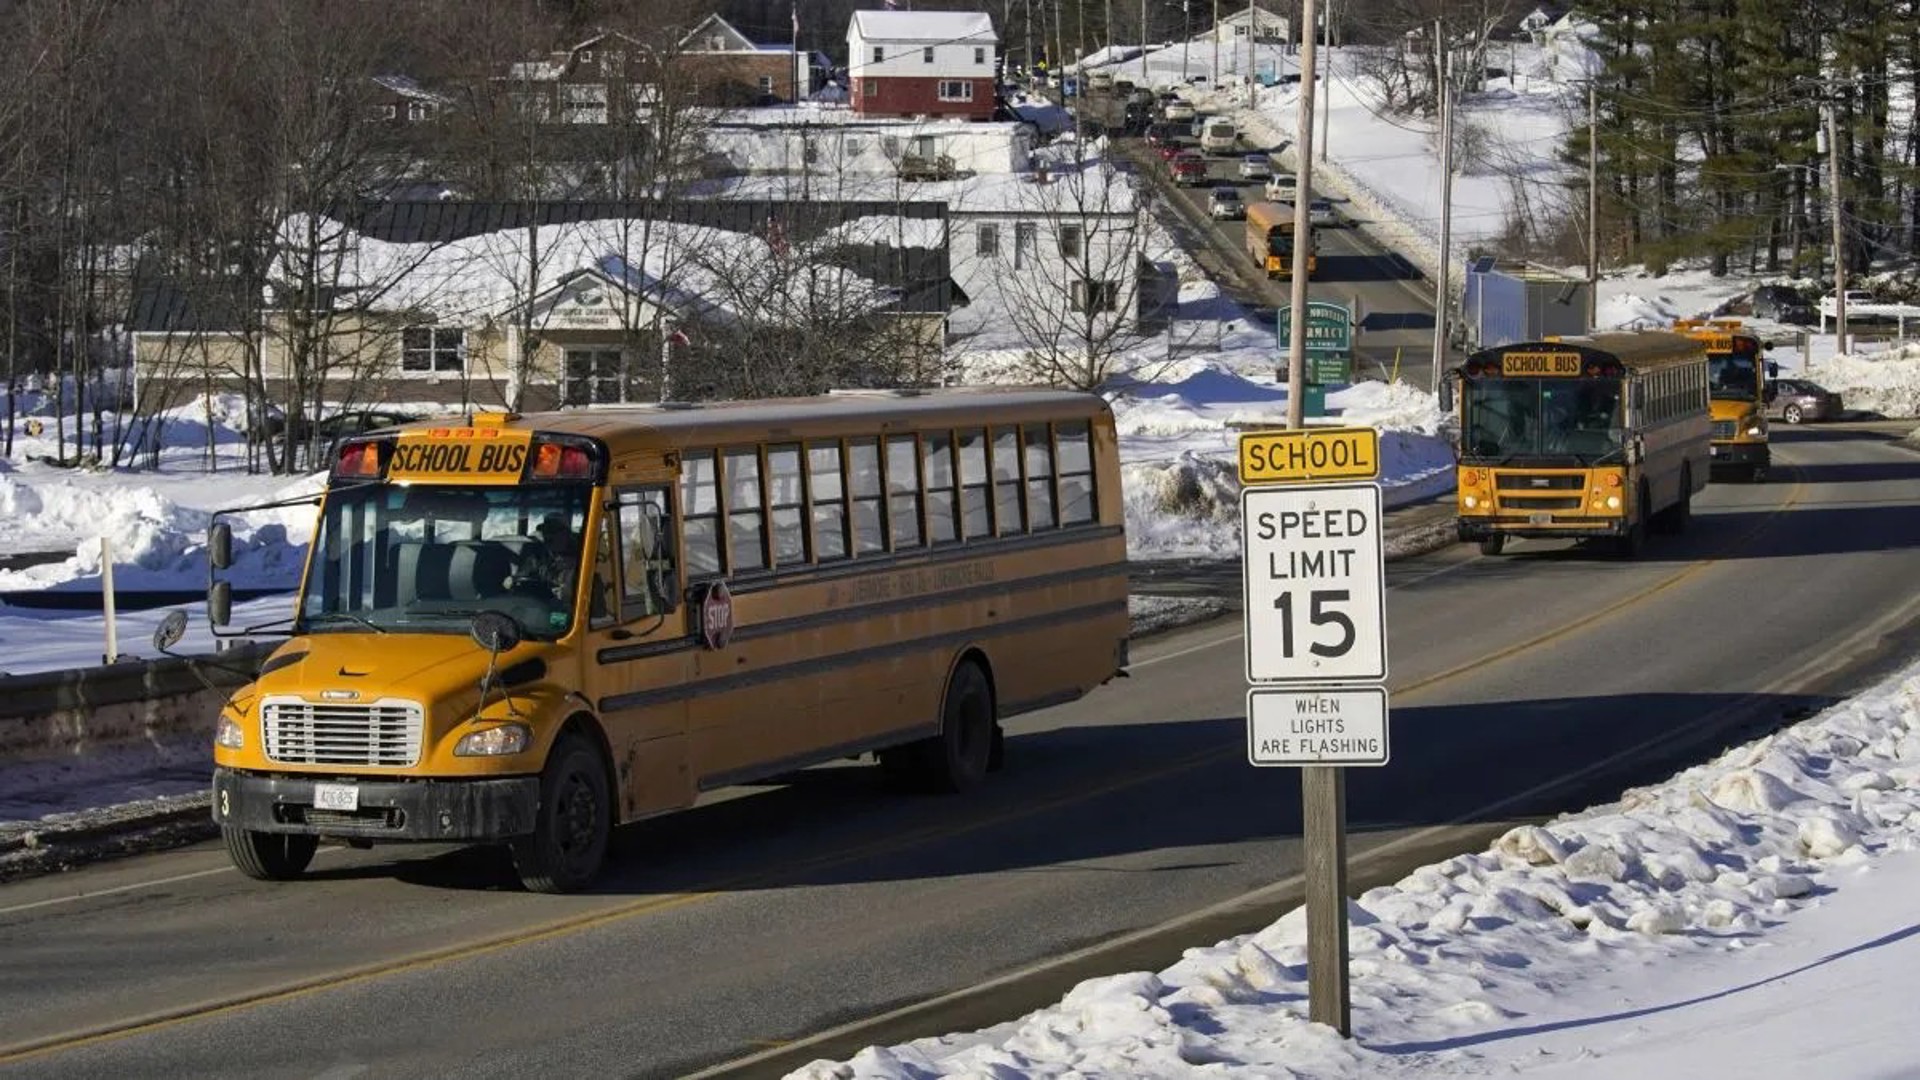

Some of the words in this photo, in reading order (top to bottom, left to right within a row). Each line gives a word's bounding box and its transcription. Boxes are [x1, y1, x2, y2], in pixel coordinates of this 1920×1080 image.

[1282, 327, 1343, 338] PRMACY
[1505, 355, 1550, 372] SCHOOL
[1554, 355, 1578, 372] BUS
[392, 444, 471, 472] SCHOOL
[477, 444, 526, 472] BUS
[1250, 439, 1368, 472] SCHOOL
[1257, 509, 1367, 540] SPEED
[1270, 549, 1356, 579] LIMIT
[708, 603, 730, 630] STOP
[1273, 589, 1356, 658] 15
[1295, 699, 1340, 714] WHEN
[1291, 719, 1345, 734] LIGHTS
[1261, 739, 1290, 754] ARE
[1300, 739, 1378, 753] FLASHING
[221, 789, 230, 816] 3
